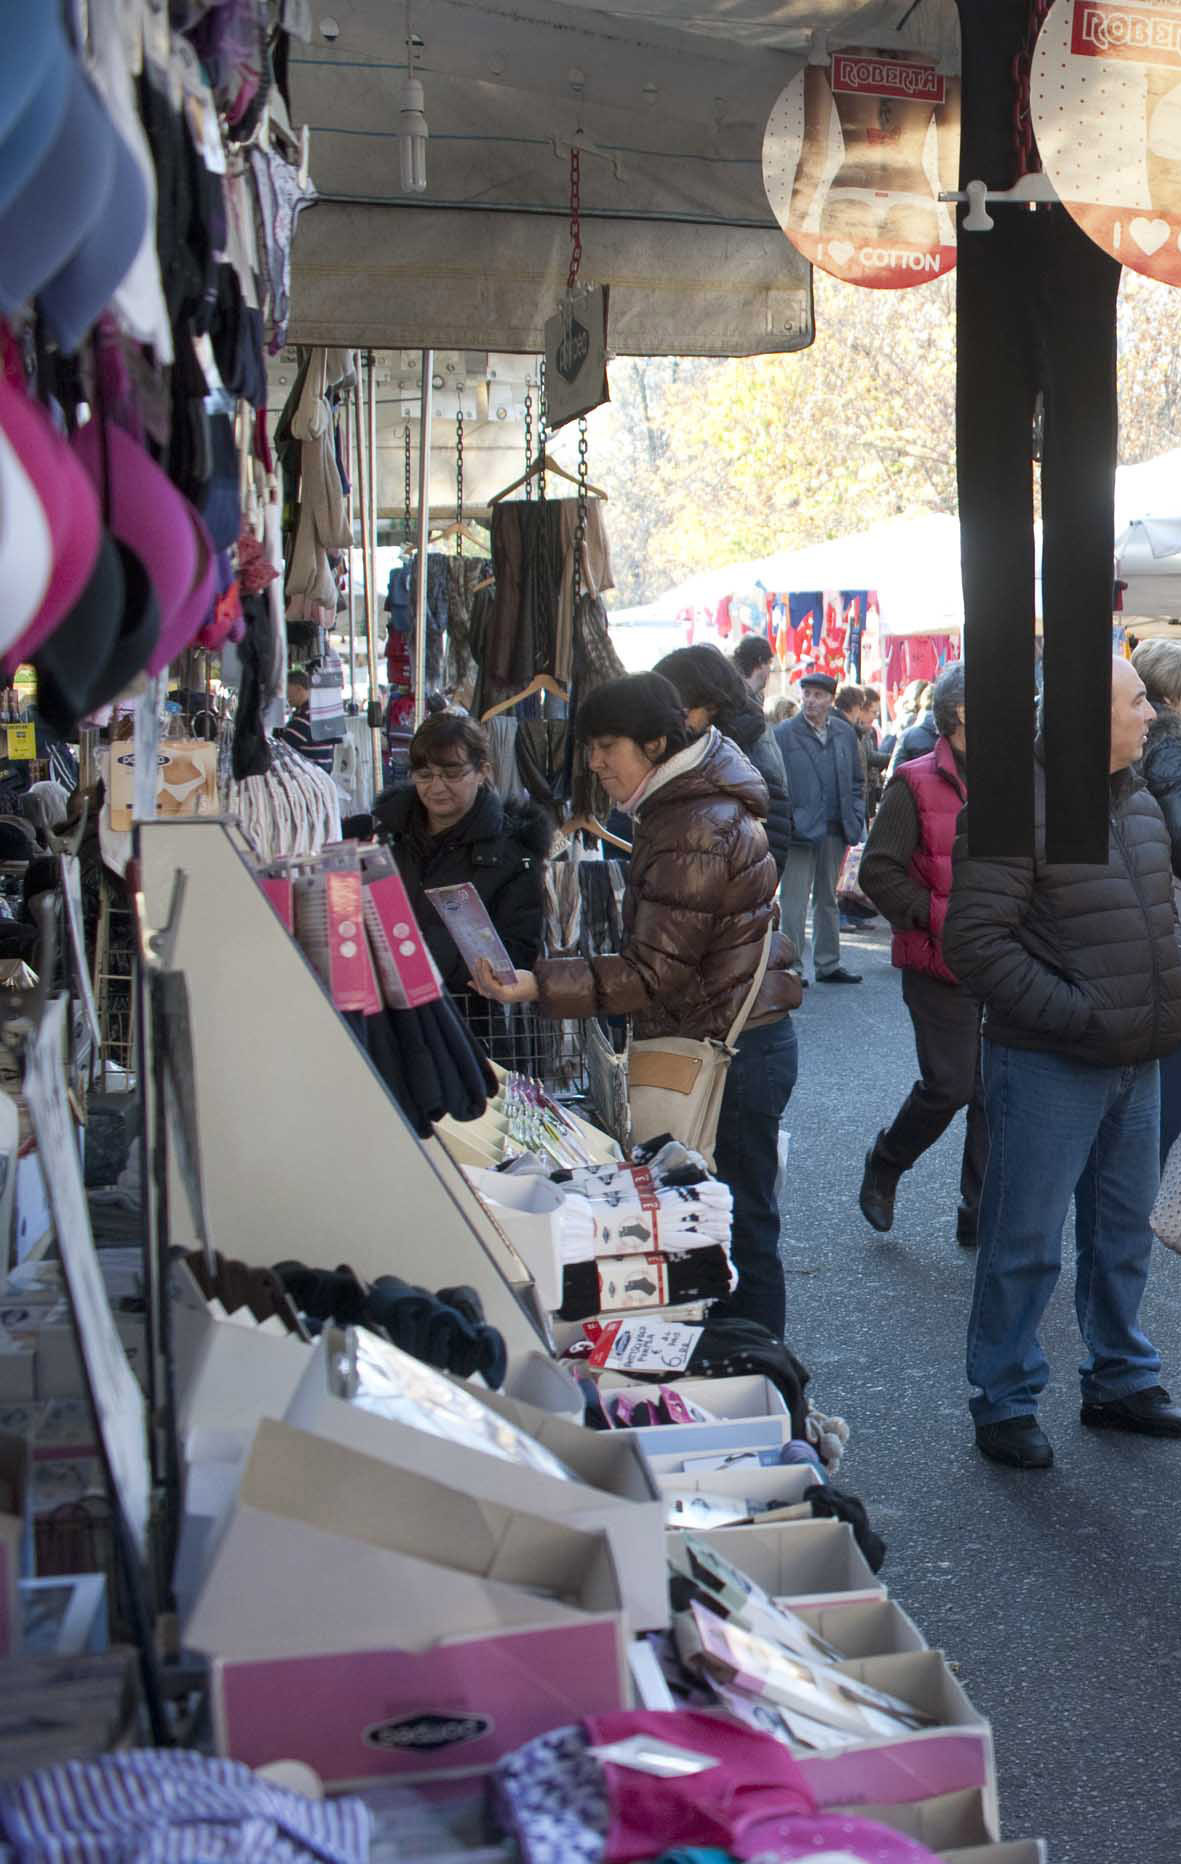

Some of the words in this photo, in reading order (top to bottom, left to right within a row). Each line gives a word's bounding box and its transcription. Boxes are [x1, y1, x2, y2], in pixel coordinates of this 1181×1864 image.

[840, 60, 937, 93] ROBERTA
[1112, 220, 1121, 250] I
[816, 243, 824, 261] I
[859, 246, 940, 273] COTTON
